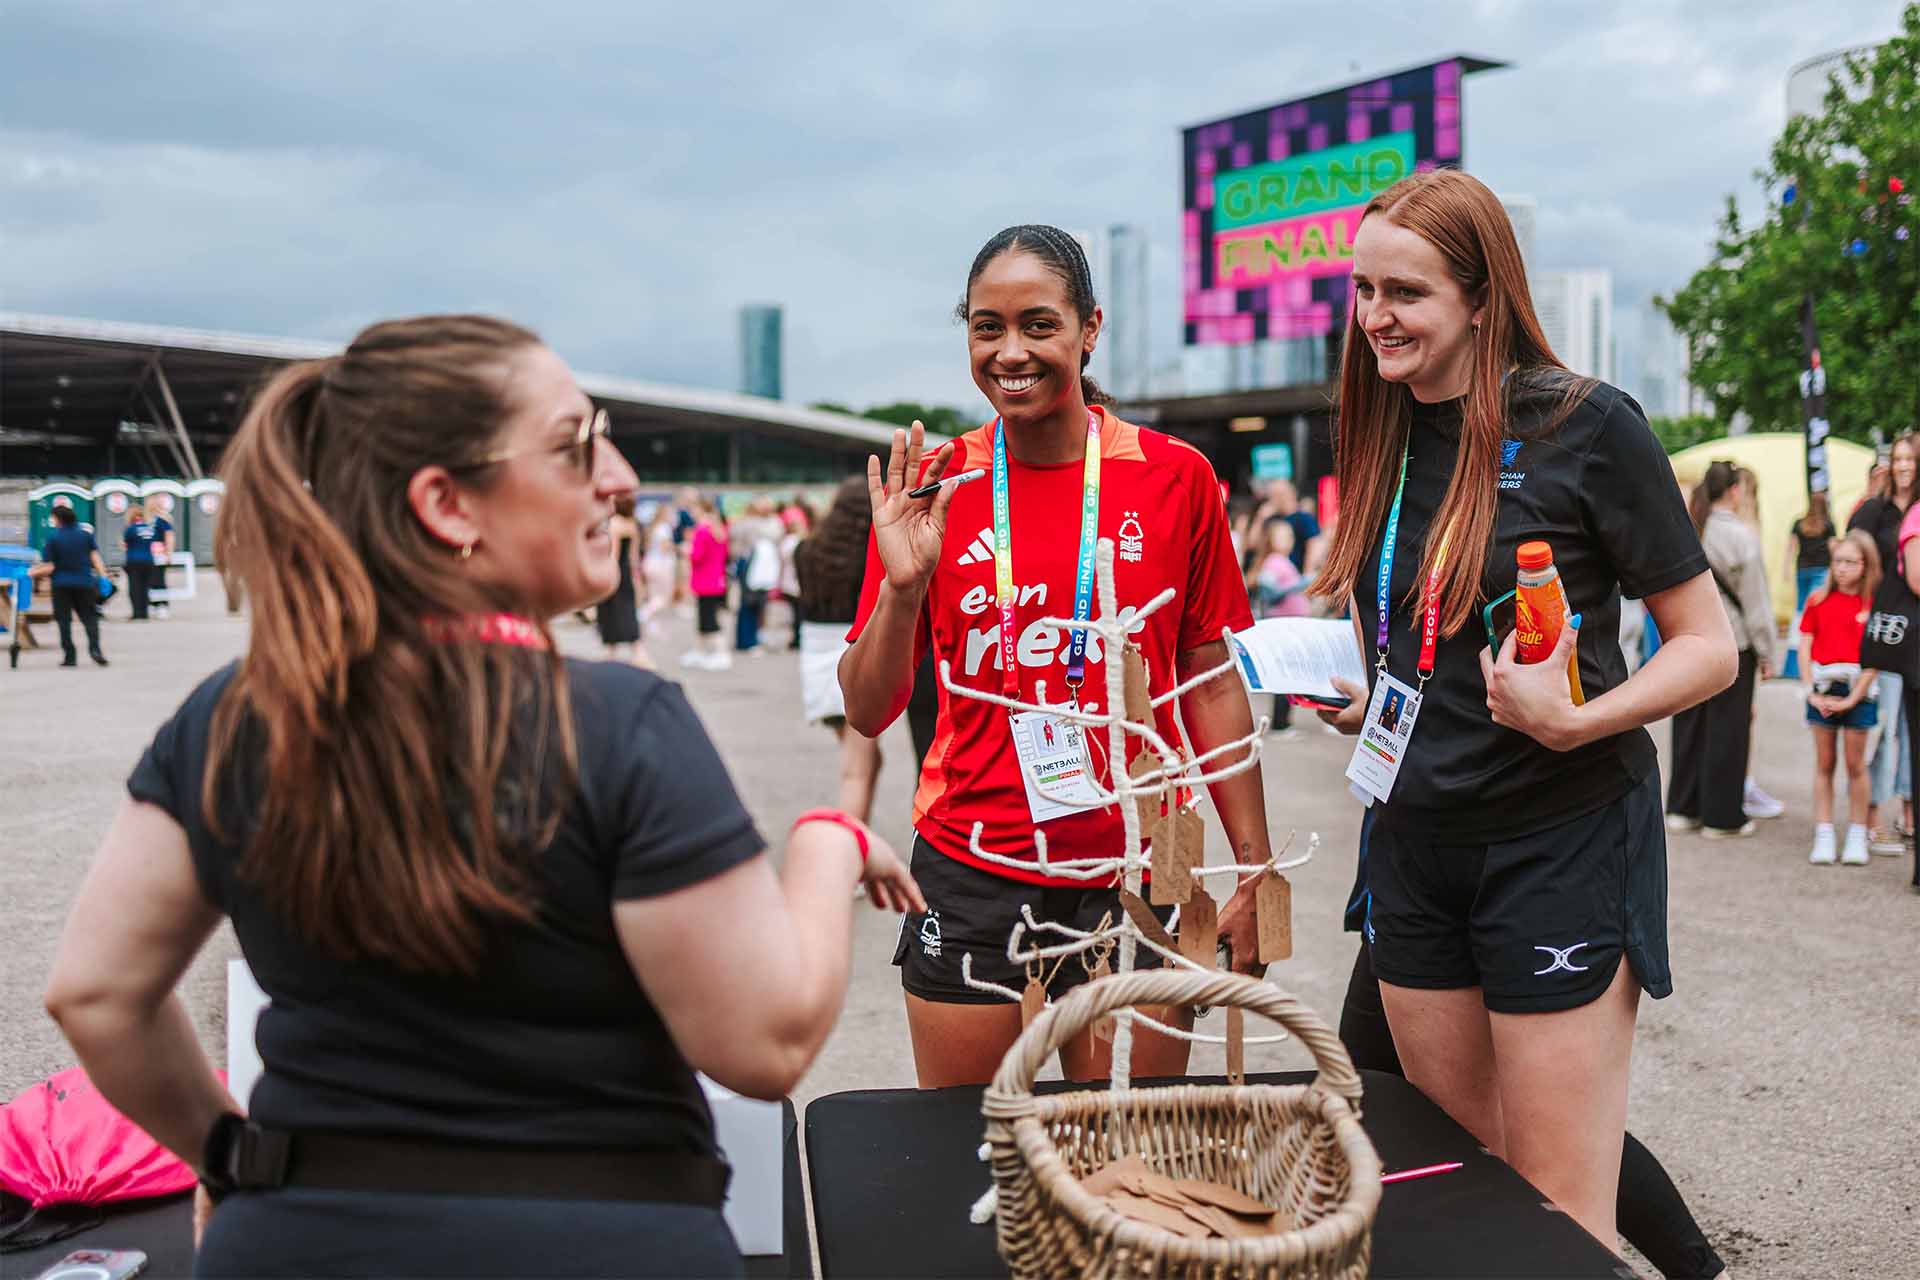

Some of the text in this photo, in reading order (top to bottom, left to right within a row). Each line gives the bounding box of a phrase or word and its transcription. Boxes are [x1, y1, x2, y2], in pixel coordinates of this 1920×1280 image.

[1222, 148, 1405, 219] GRAND
[1080, 549, 1093, 594] FINAL
[1378, 519, 1398, 622] GRAND FINAL
[1425, 607, 1437, 646] 2025
[1516, 630, 1543, 645] zade
[1004, 635, 1015, 672] 2025
